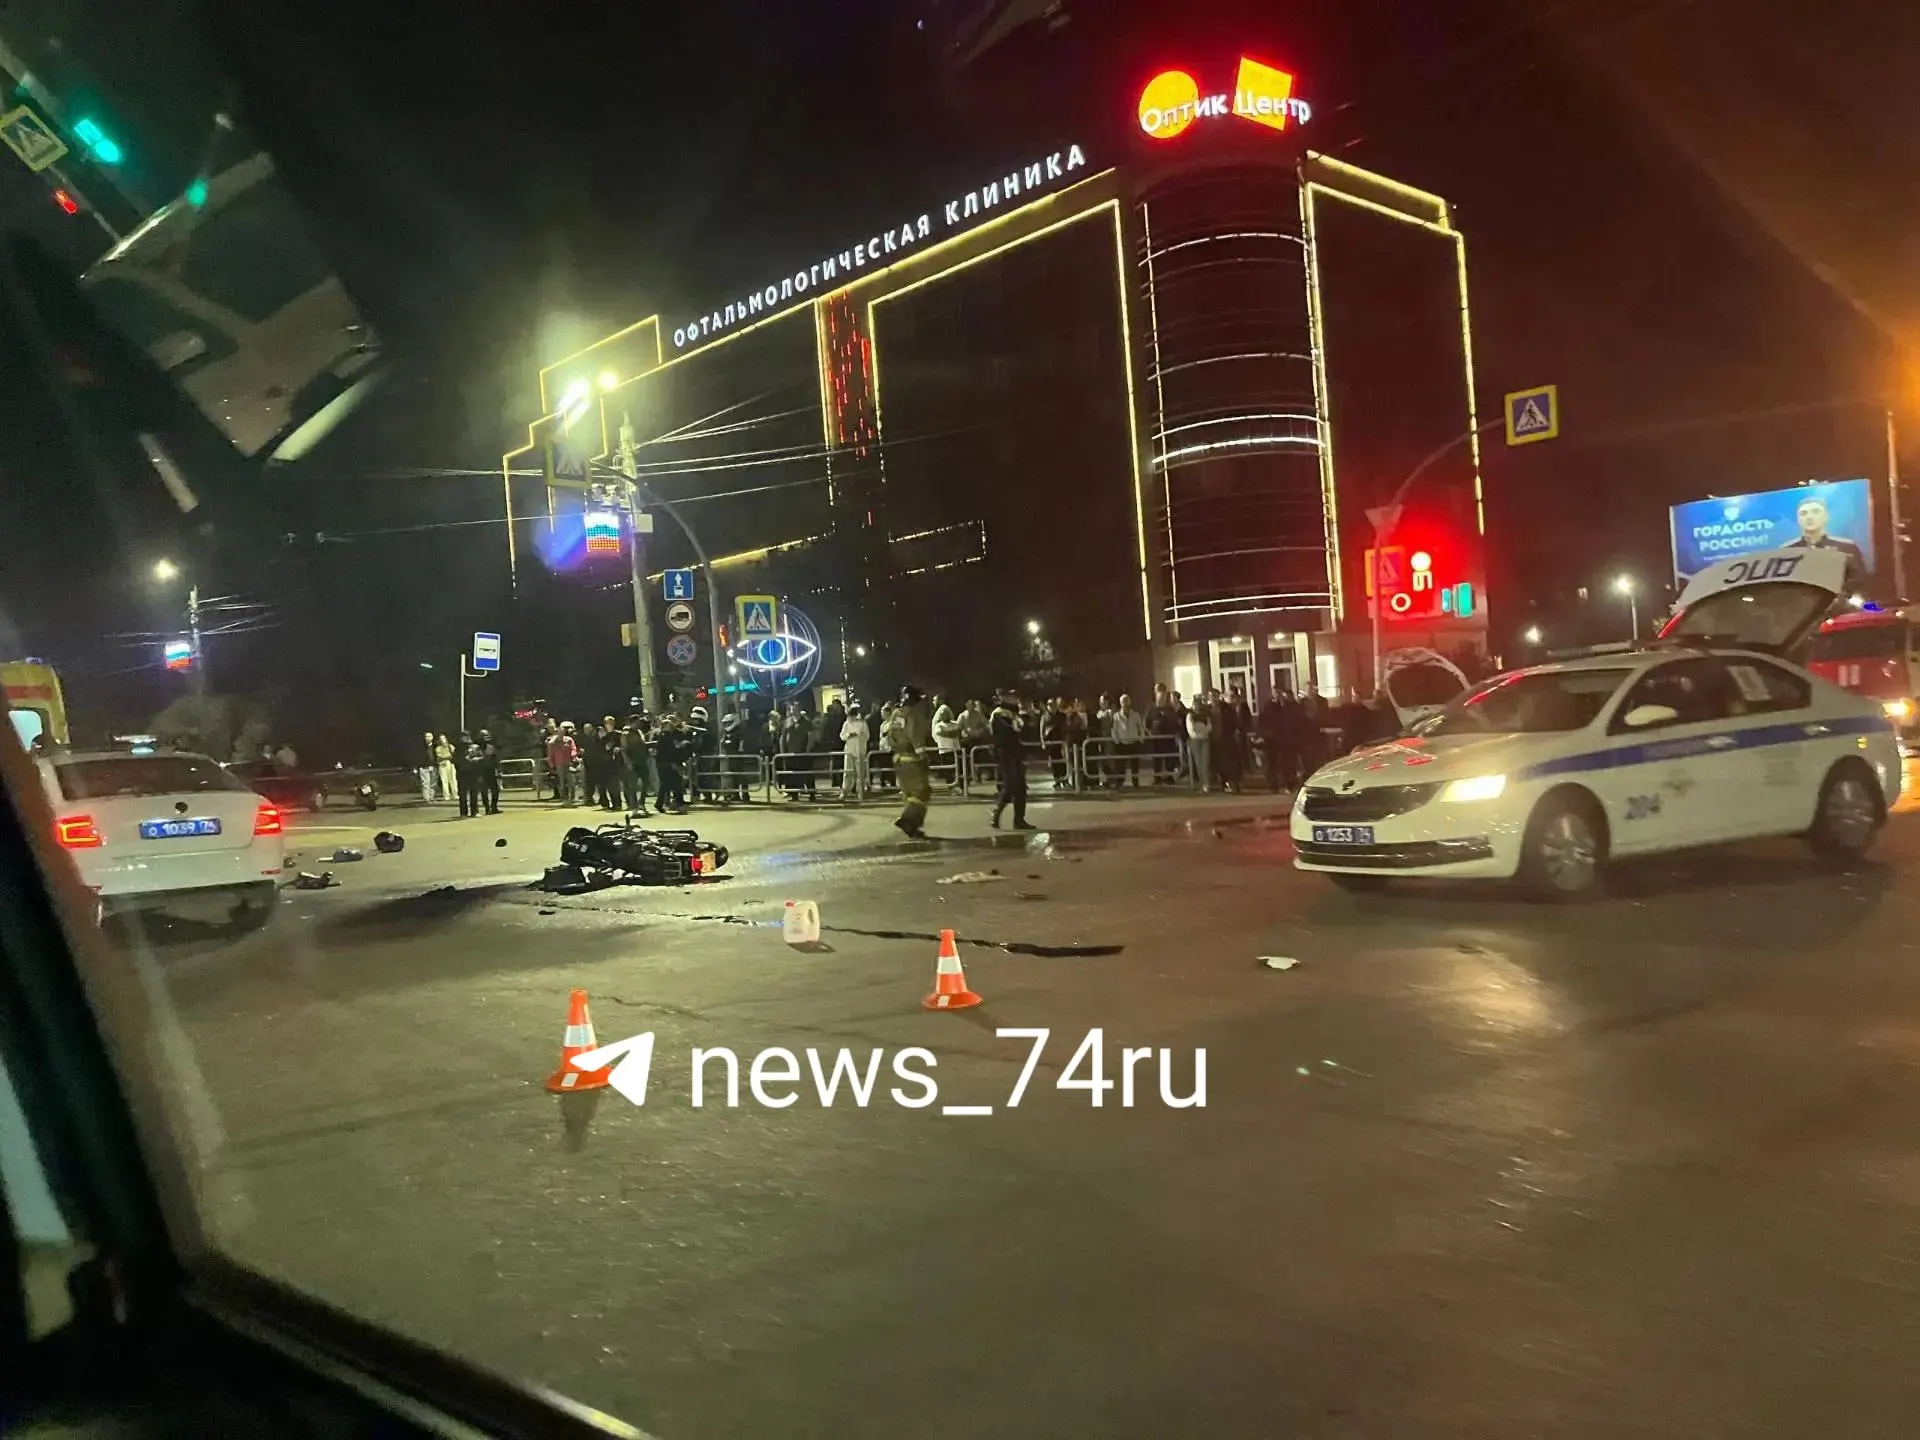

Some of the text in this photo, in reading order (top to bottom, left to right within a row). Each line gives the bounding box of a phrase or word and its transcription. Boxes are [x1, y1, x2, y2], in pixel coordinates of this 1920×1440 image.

[1140, 90, 1312, 133] Оптик Центр
[673, 143, 1086, 348] ОФТАЛЬМОЛОГИЧЕСКАЯ КЛИНИКА
[1693, 519, 1774, 538] ГОРДОСТЬ
